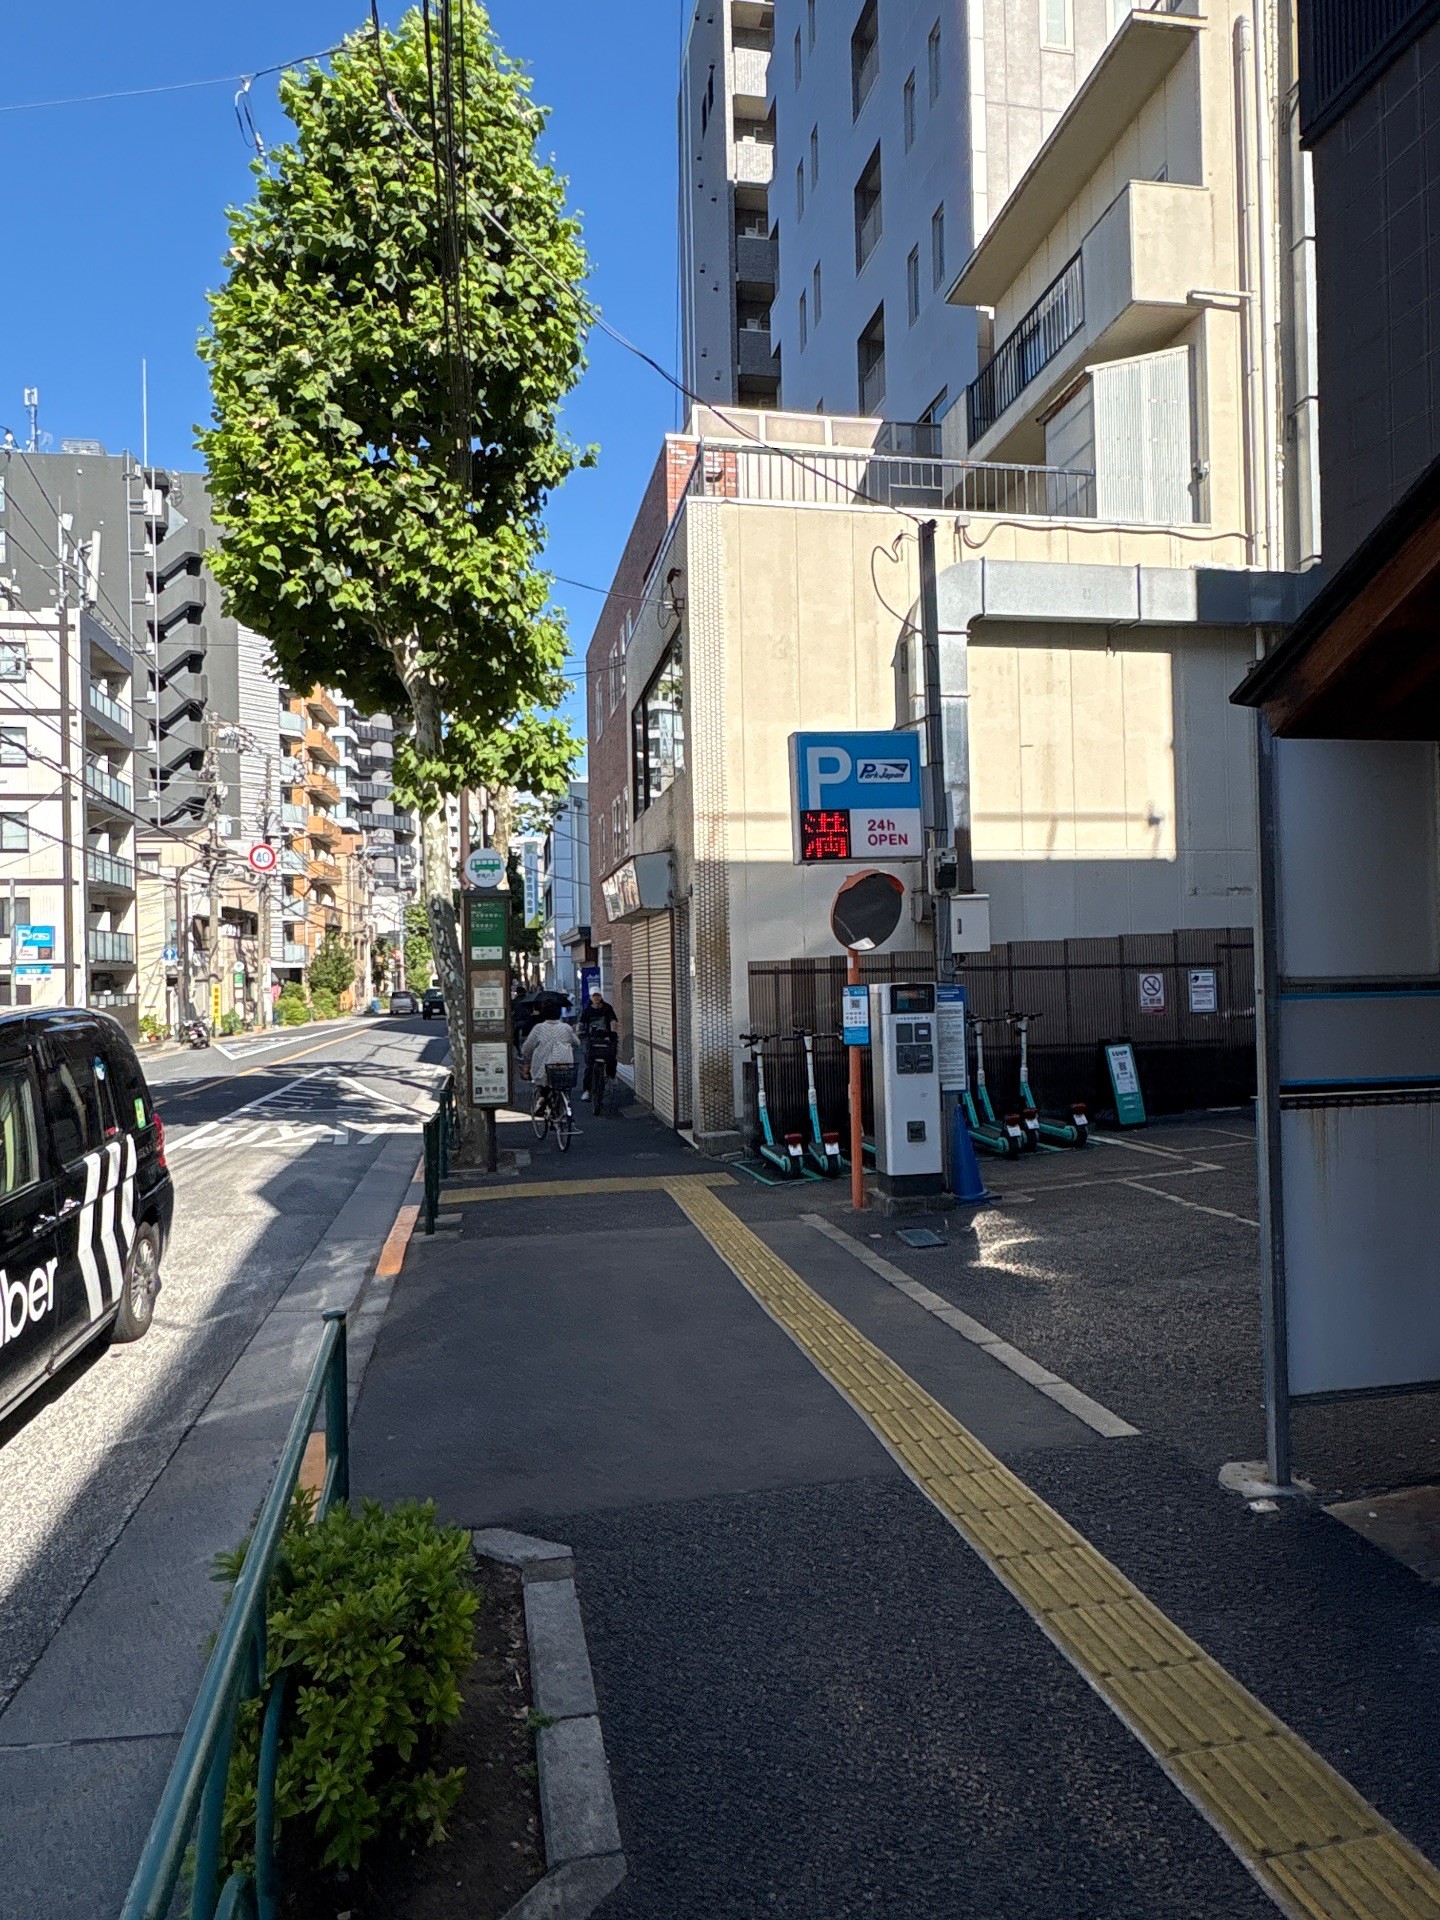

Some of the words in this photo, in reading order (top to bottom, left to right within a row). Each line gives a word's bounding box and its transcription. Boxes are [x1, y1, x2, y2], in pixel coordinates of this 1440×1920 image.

[806, 746, 852, 810] P
[859, 763, 879, 779] Park
[879, 767, 904, 780] Japan
[867, 819, 895, 831] 24h
[867, 833, 908, 846] OPEN
[255, 851, 270, 864] 40
